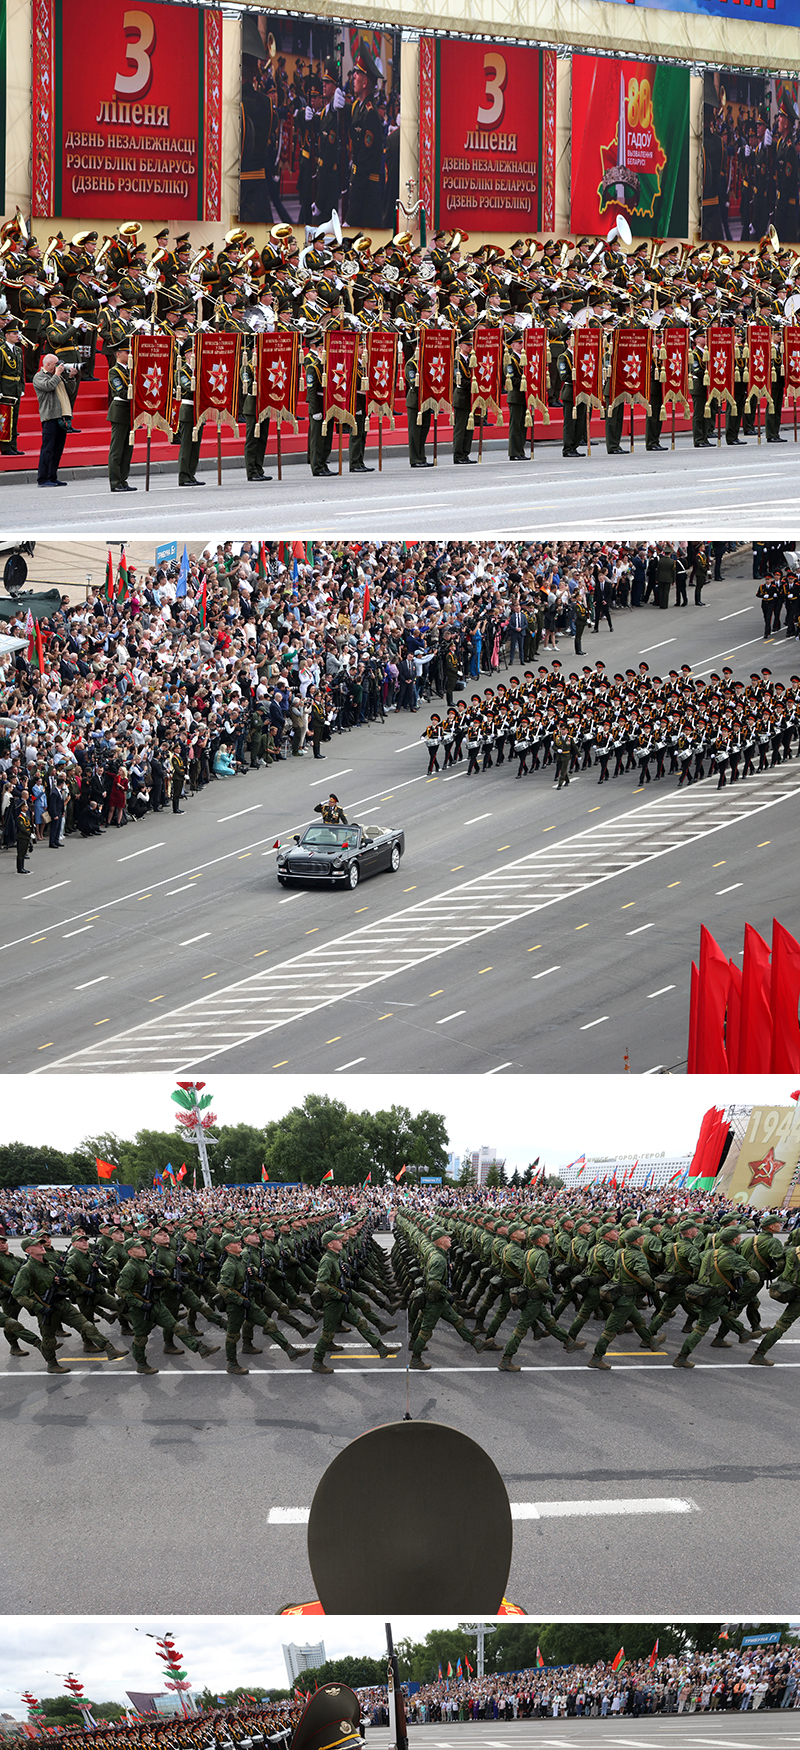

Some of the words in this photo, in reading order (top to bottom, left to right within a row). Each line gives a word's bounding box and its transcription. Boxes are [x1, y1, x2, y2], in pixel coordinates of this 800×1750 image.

[114, 10, 155, 94] 3
[477, 52, 507, 124] 3
[96, 94, 169, 126] ліпеня
[627, 77, 651, 129] 80
[65, 131, 105, 149] ДЗЕНЬ
[107, 134, 196, 155] НЕЗАЛЕЖНАСЦІ
[464, 124, 517, 152] ліпеня
[627, 130, 652, 149] ГАДОЎ
[627, 149, 653, 158] ВЫЗВАЛЕННЯ
[627, 158, 646, 166] БЕЛАРУСІ
[66, 154, 137, 172] РЭСПУБЛІКІ
[139, 158, 196, 175] БЕЛАРУСЬ
[442, 157, 470, 172] ДЗЕНЬ
[472, 159, 537, 175] НЕЗАЛЕЖНАСЦІ
[71, 174, 115, 193] (ДЗЕНЬ
[118, 177, 189, 198] РЭСПУБЛІКІ)
[443, 176, 493, 191] РЭСПУБЛІКІ
[495, 179, 537, 193] БЕЛАРУСЬ
[446, 194, 478, 210] (ДЗЕНЬ
[479, 196, 531, 213] РЭСПУБЛІКІ)
[615, 1151, 666, 1161] ГОРОД-ГЕРОЙ
[744, 1636, 768, 1644] ТРИБУНА
